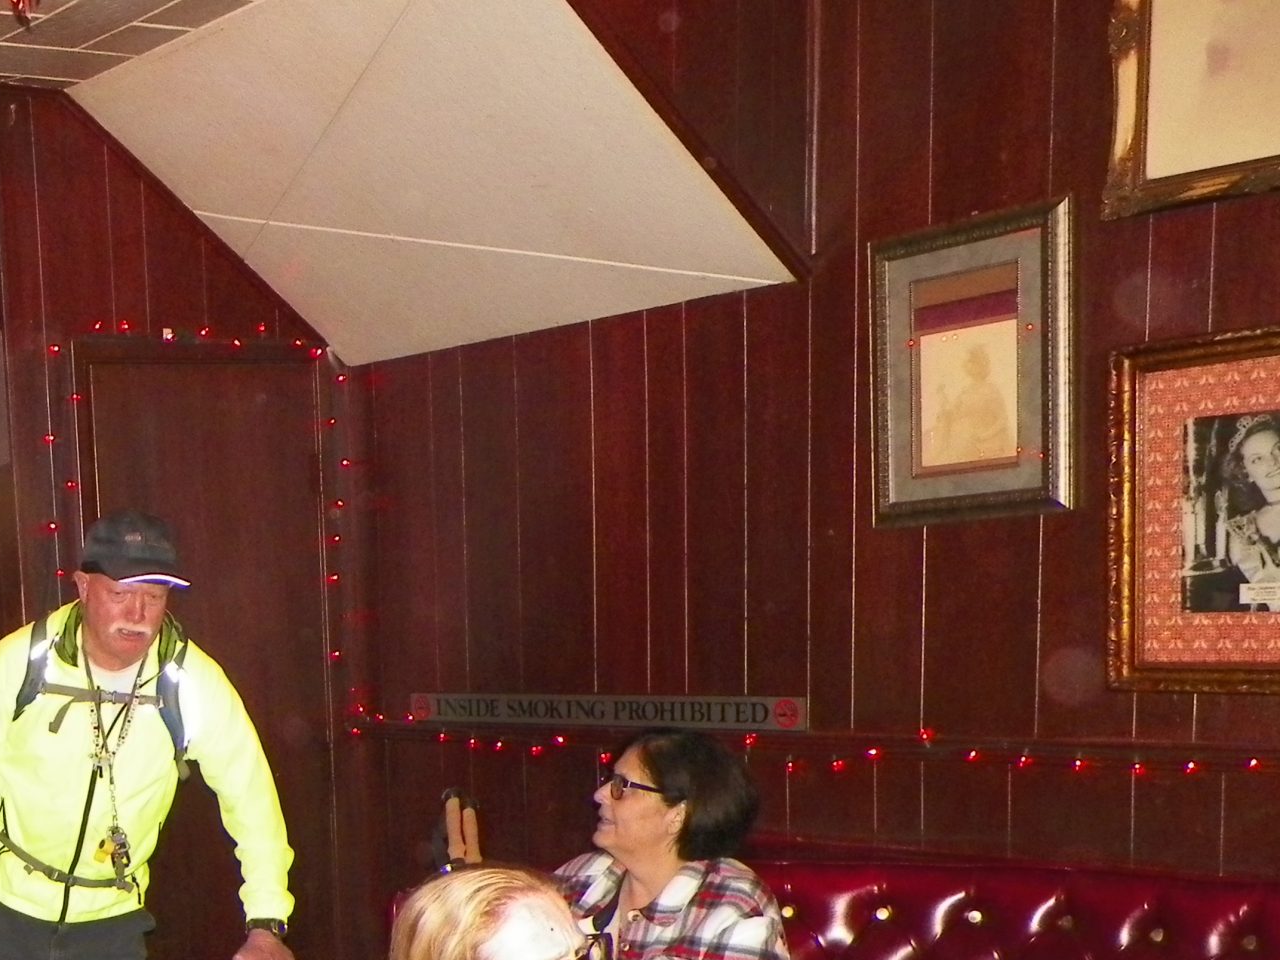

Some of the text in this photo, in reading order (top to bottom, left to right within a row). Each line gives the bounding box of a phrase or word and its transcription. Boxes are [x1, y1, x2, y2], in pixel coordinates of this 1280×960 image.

[436, 698, 769, 723] INSIDE SMOKING PROHIBITED
